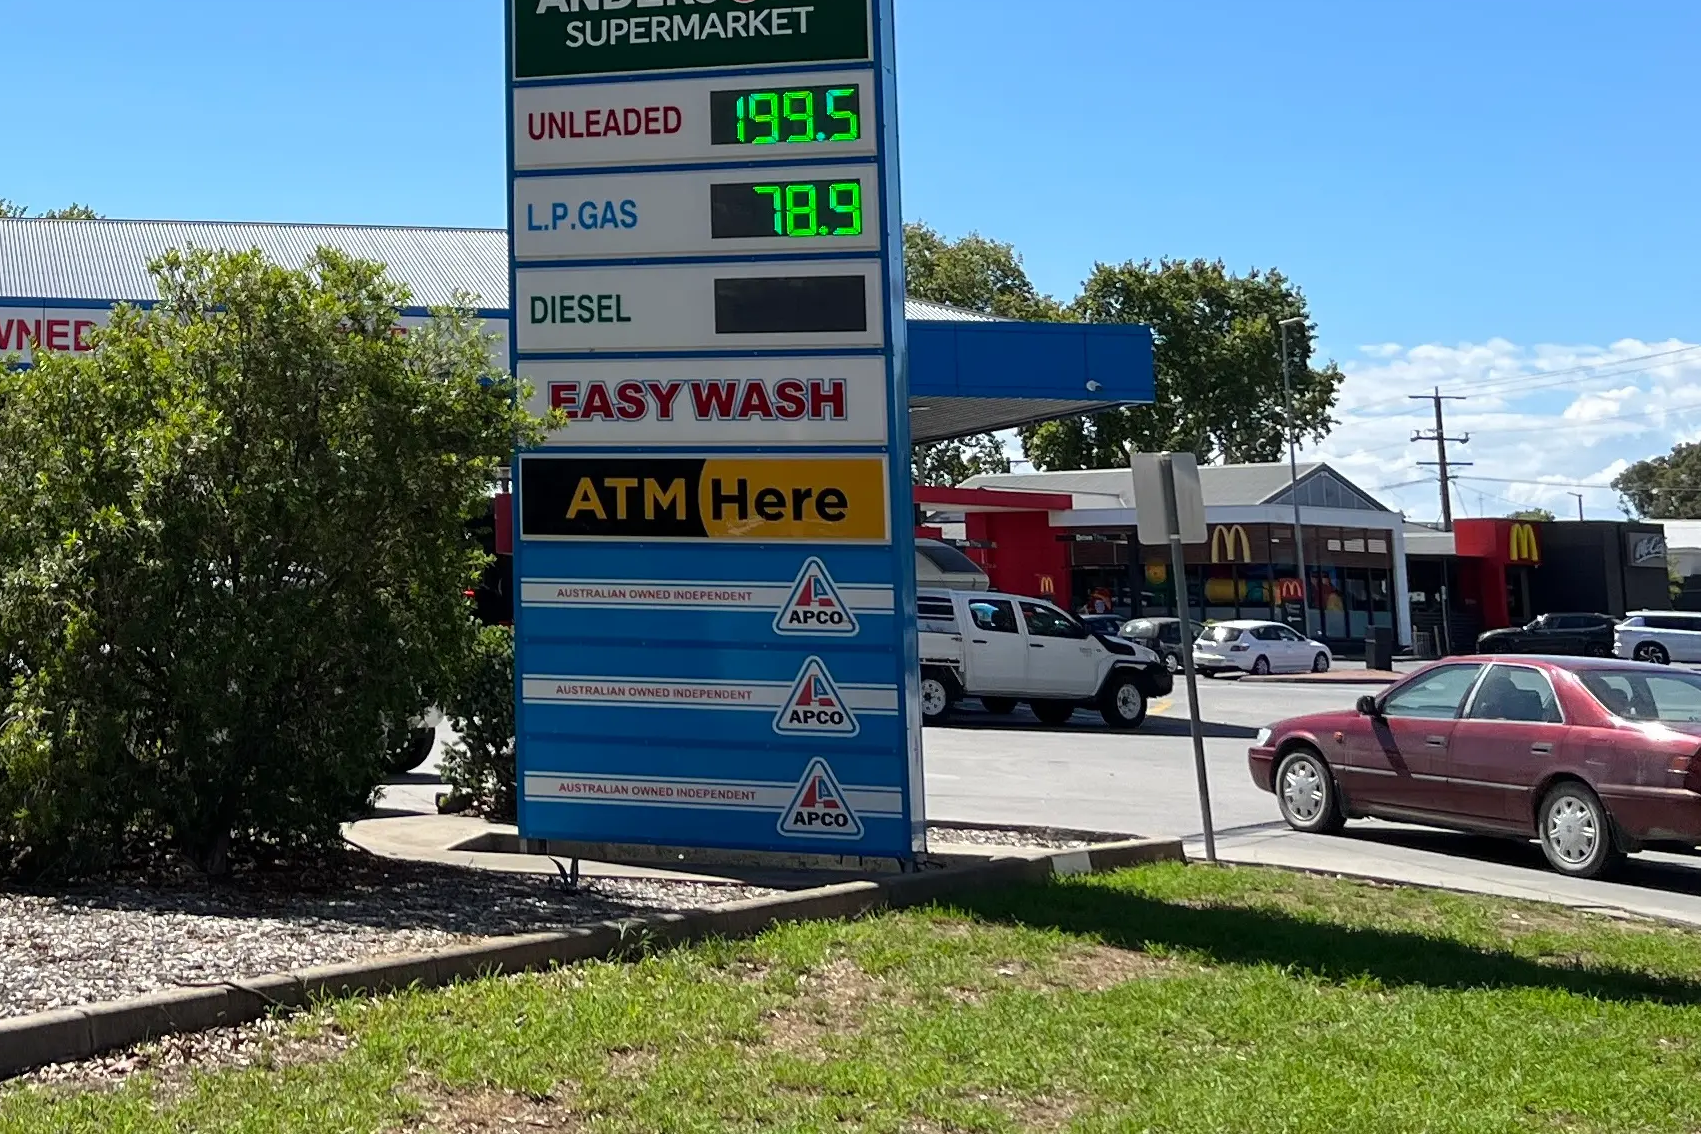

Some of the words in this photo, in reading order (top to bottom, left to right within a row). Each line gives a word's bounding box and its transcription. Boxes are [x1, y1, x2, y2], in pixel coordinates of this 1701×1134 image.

[565, 6, 814, 48] SUPERMARKET
[528, 106, 682, 140] UNLEADED
[736, 88, 859, 145] 199.5
[527, 199, 638, 231] L.P.GAS
[753, 183, 863, 236] 78.9
[530, 294, 631, 325] DIESEL
[565, 477, 686, 521] ATM
[711, 478, 849, 523] Here
[556, 588, 627, 599] AUSTRALIAN
[629, 589, 671, 600] OWNED
[673, 591, 753, 602] INDEPENDENT
[788, 610, 844, 625] APCO
[556, 685, 626, 697] AUSTRALIAN
[628, 687, 670, 698] OWNED
[673, 688, 753, 701] INDEPENDENT
[788, 709, 844, 726] APCO
[559, 782, 629, 796] AUSTRALIAN
[631, 785, 674, 797] OWNED
[676, 788, 756, 801] INDEPENDENT
[793, 811, 849, 828] APCO
